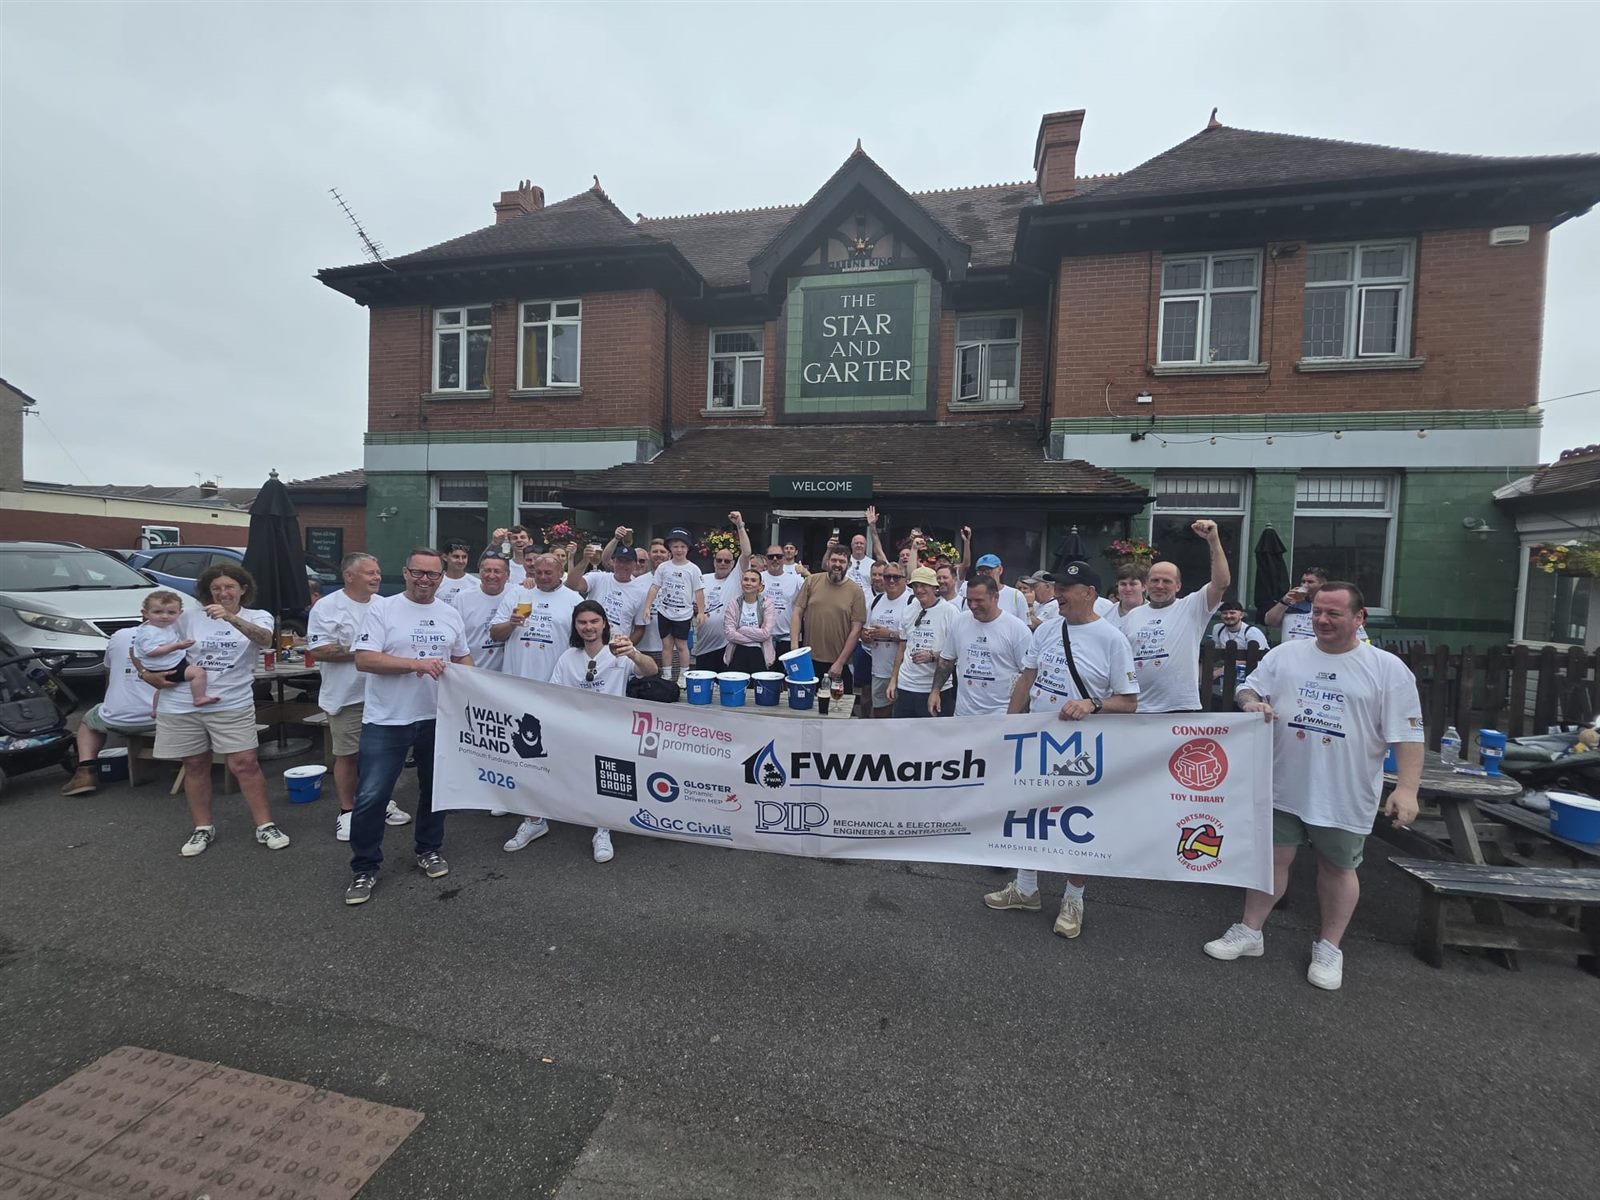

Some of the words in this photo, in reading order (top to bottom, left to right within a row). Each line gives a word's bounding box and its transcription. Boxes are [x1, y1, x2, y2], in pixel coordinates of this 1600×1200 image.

[840, 293, 876, 308] THE
[822, 313, 892, 338] STAR
[829, 340, 881, 358] AND
[803, 359, 912, 384] GARTER
[791, 481, 853, 492] WELCOME
[472, 706, 513, 728] WALK
[1302, 716, 1342, 730] FWMarsh
[476, 721, 506, 740] THE
[656, 716, 733, 743] hargreaves
[1171, 725, 1230, 736] CONNORS
[459, 730, 510, 754] ISLAND
[661, 738, 732, 760] promotions
[599, 759, 617, 771] THE
[790, 749, 986, 783] FWMarsh
[1003, 730, 1104, 786] TMJ
[477, 767, 516, 790] 2026
[599, 769, 633, 785] SHORE
[600, 779, 633, 793] GROUP
[1013, 778, 1082, 788] INTERIORS
[683, 780, 732, 793] GLOSTER
[684, 788, 714, 798] Dynamic
[1170, 792, 1187, 801] TOY
[1189, 794, 1225, 803] LIBRARY
[754, 800, 830, 832] PIP
[833, 819, 895, 829] MECHANICAL
[905, 821, 964, 829] ELECTRICAL
[1003, 805, 1096, 844] HFC
[1175, 812, 1225, 830] PORTSMOUTH
[660, 817, 684, 832] GC
[686, 821, 732, 836] Civils
[833, 827, 887, 836] ENGINEERS
[899, 826, 968, 836] CONTRACTORS
[988, 842, 1039, 853] HAMPSHIRE
[1041, 846, 1065, 856] FLAG
[1067, 848, 1113, 860] COMPANY
[1177, 856, 1223, 872] LIFEGUARDS
